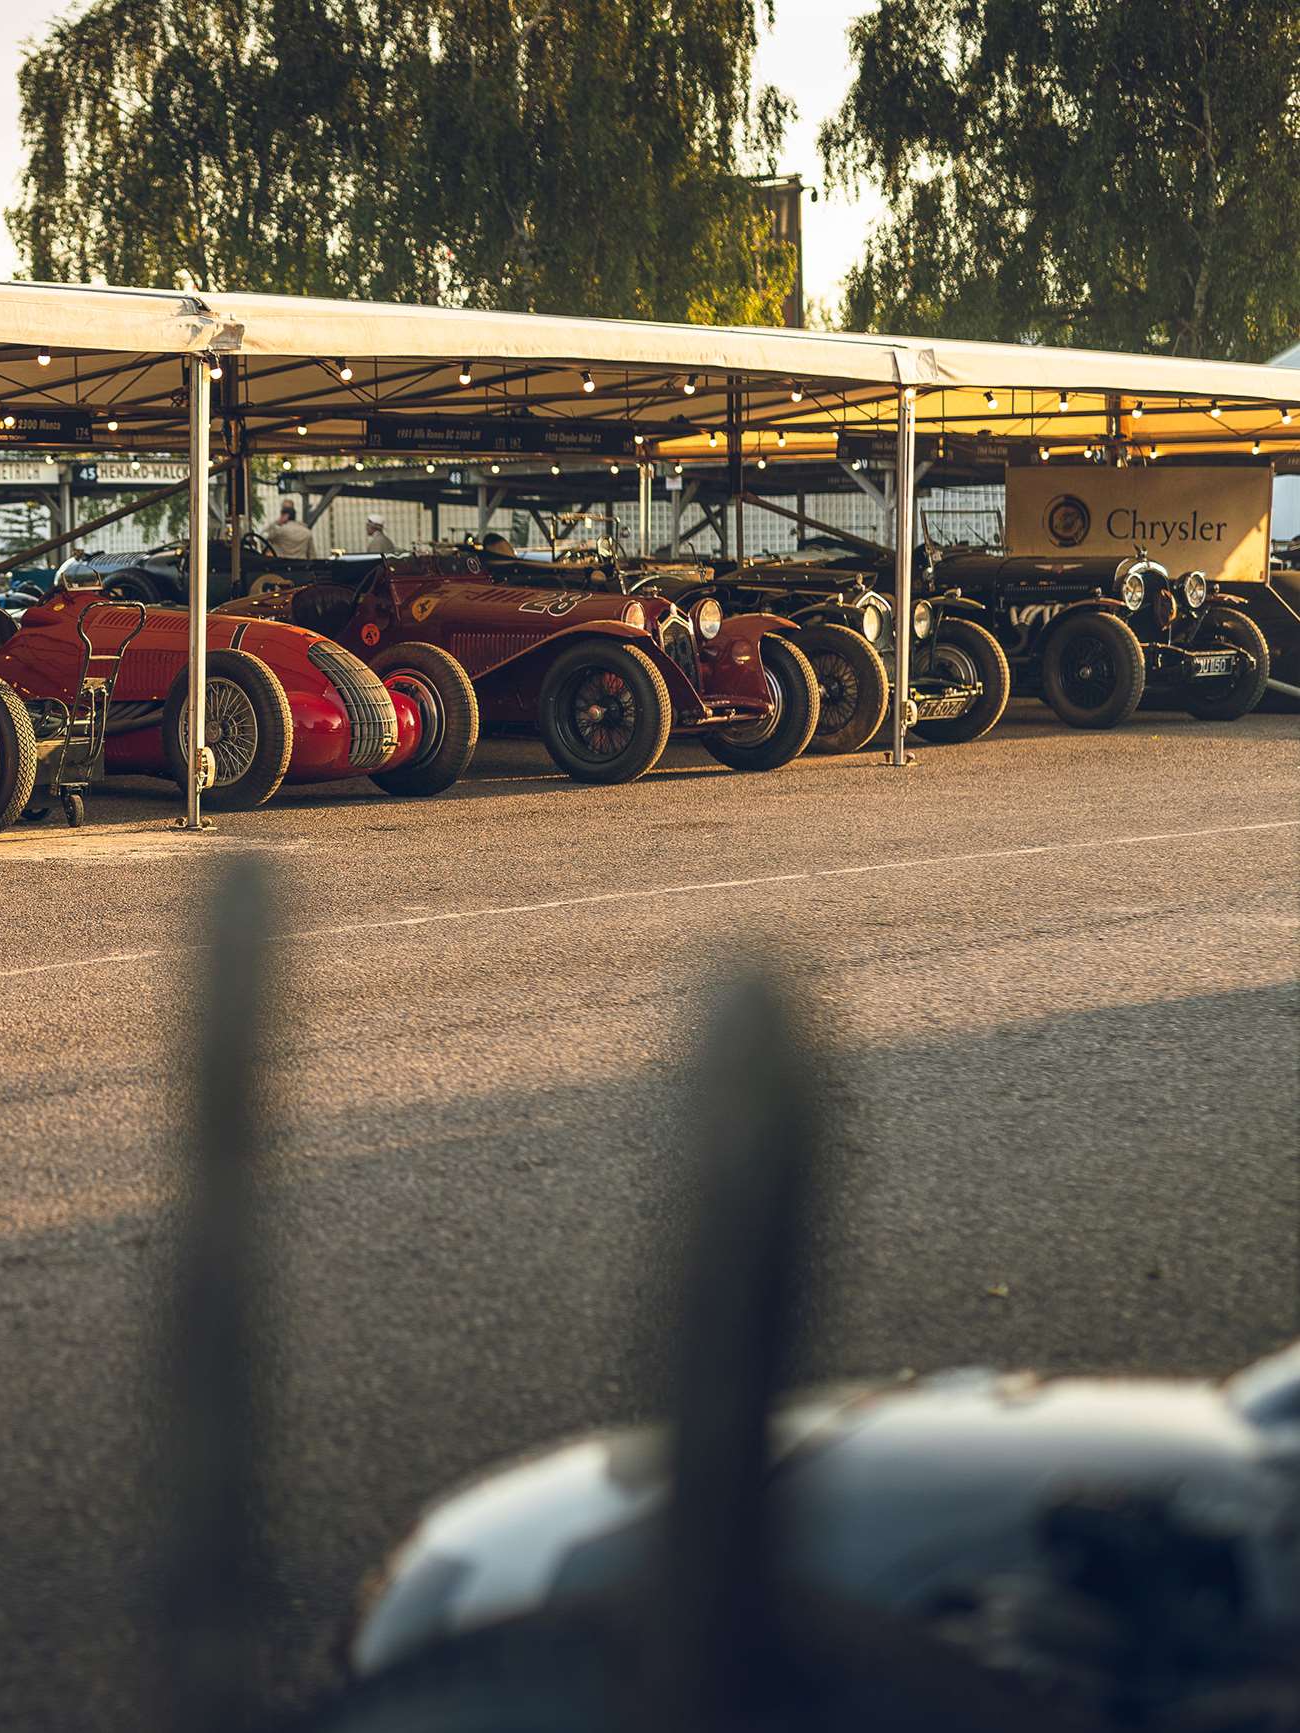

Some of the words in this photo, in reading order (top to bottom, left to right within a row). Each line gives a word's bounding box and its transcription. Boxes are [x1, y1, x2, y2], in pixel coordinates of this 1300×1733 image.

[75, 426, 90, 437] 174
[79, 467, 96, 481] 45
[1106, 508, 1228, 547] Chrysler
